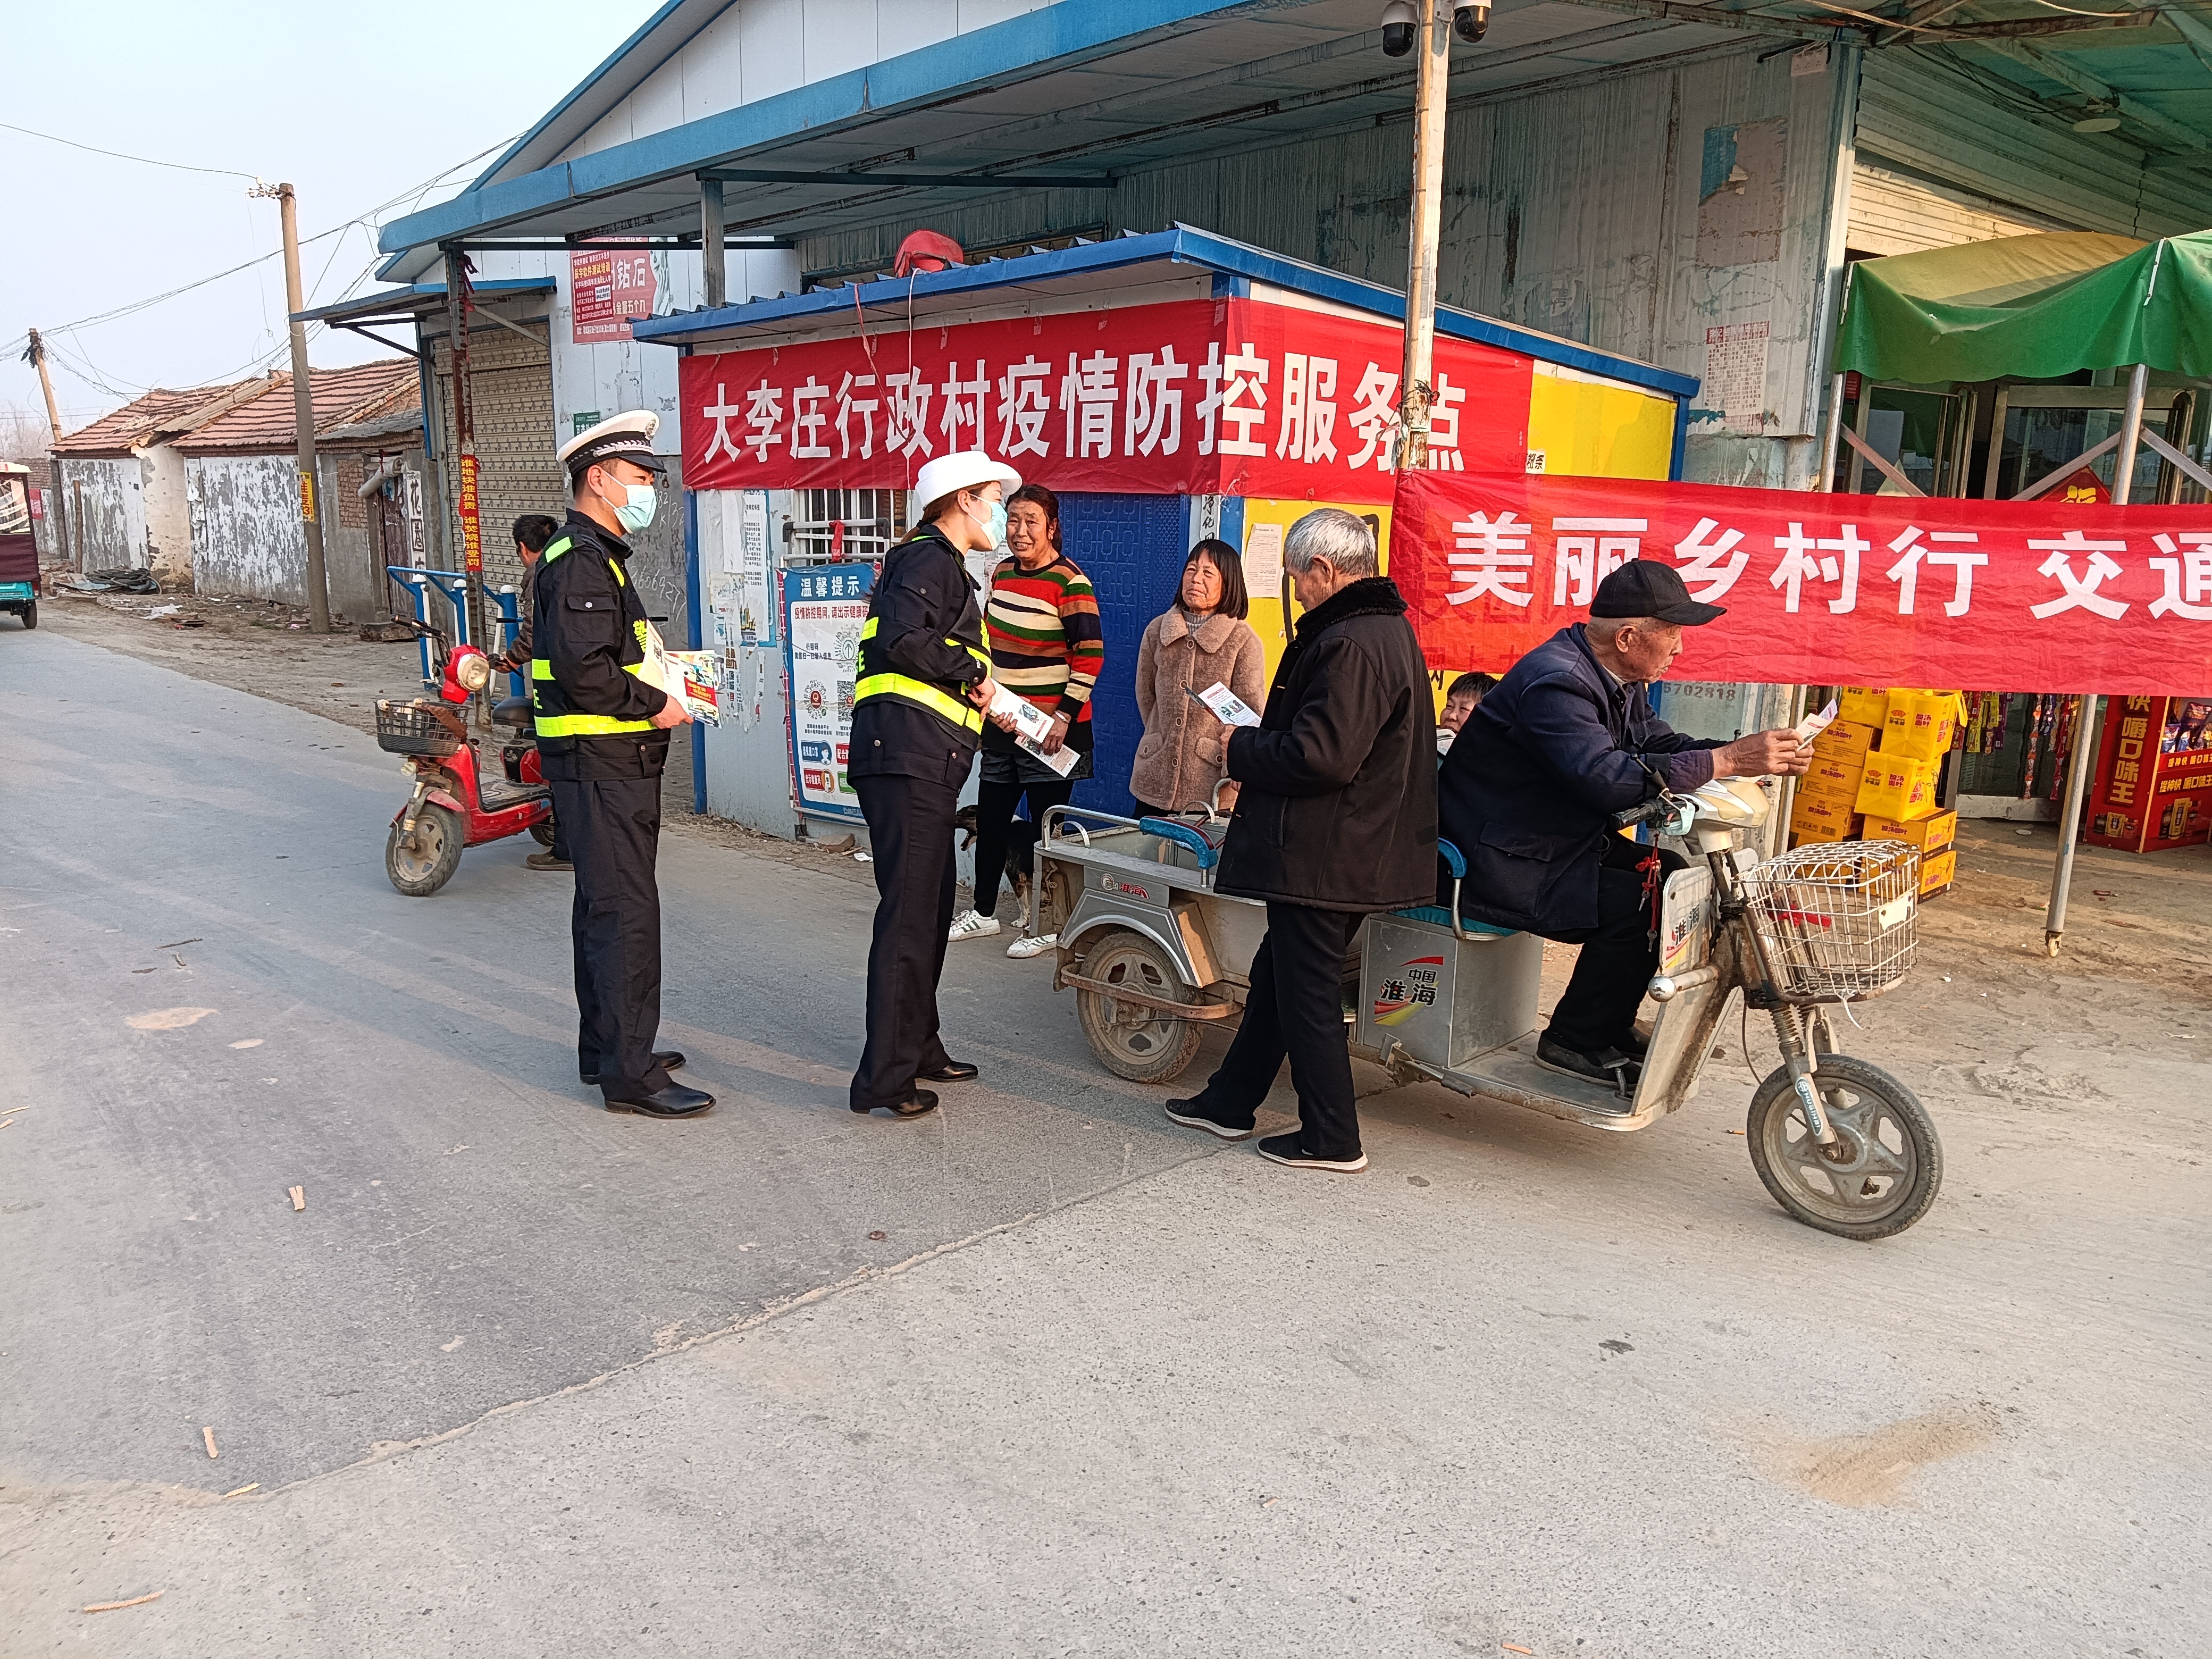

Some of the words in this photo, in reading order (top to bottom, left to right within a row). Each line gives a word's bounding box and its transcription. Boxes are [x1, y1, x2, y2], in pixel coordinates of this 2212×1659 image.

[703, 342, 1466, 475] 大李庄行政村疫情防控服务点
[460, 459, 476, 510] 谁地块谁负责
[801, 576, 859, 597] 温馨提示
[1444, 510, 1989, 617] 美丽乡村行
[2027, 530, 2212, 621] 交通
[2109, 717, 2148, 804] 嚼口味王
[1380, 978, 1437, 1007] 淮海
[1408, 968, 1437, 984] 中国
